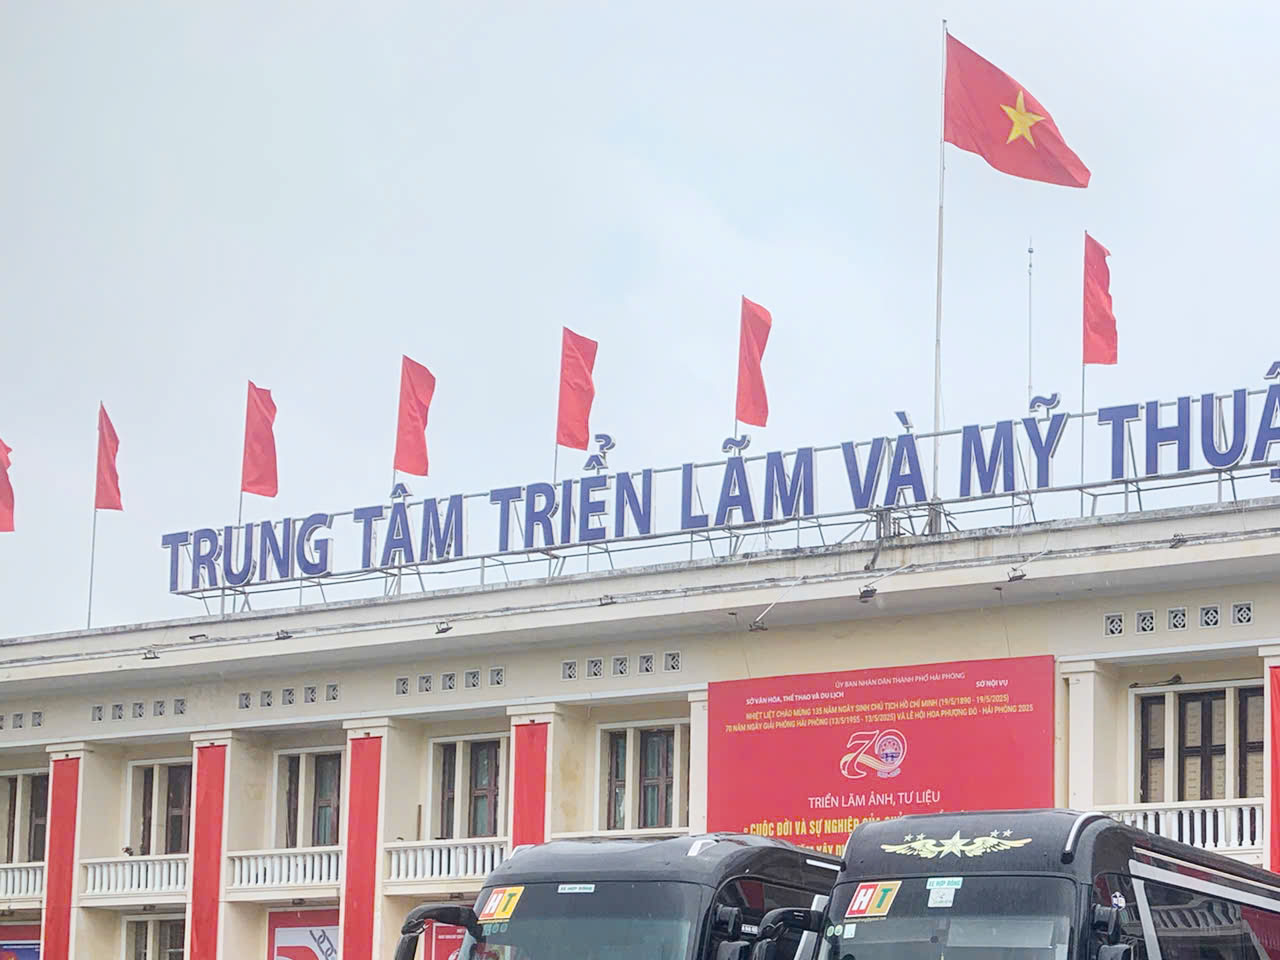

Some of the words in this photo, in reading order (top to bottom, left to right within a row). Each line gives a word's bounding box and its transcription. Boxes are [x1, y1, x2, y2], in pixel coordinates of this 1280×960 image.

[161, 512, 332, 593] TRUNG
[354, 484, 465, 569] TÂM
[491, 433, 655, 553] TRIỂN
[680, 434, 814, 530] LÃM
[841, 410, 928, 508] VÀ
[959, 392, 1069, 498] MỸ
[844, 680, 858, 688] BAN
[820, 692, 830, 700] DU
[808, 792, 840, 809] TRIỂN
[841, 793, 866, 808] LÃM
[868, 790, 896, 808] ẢNH,
[898, 791, 914, 805] TƯ
[915, 790, 941, 805] LIỆU
[776, 817, 792, 836] ĐỜI
[794, 816, 807, 836] VÀ
[809, 817, 824, 838] SỰ
[824, 815, 859, 836] NGHIỆP
[484, 892, 517, 914] HT
[851, 888, 893, 911] HT
